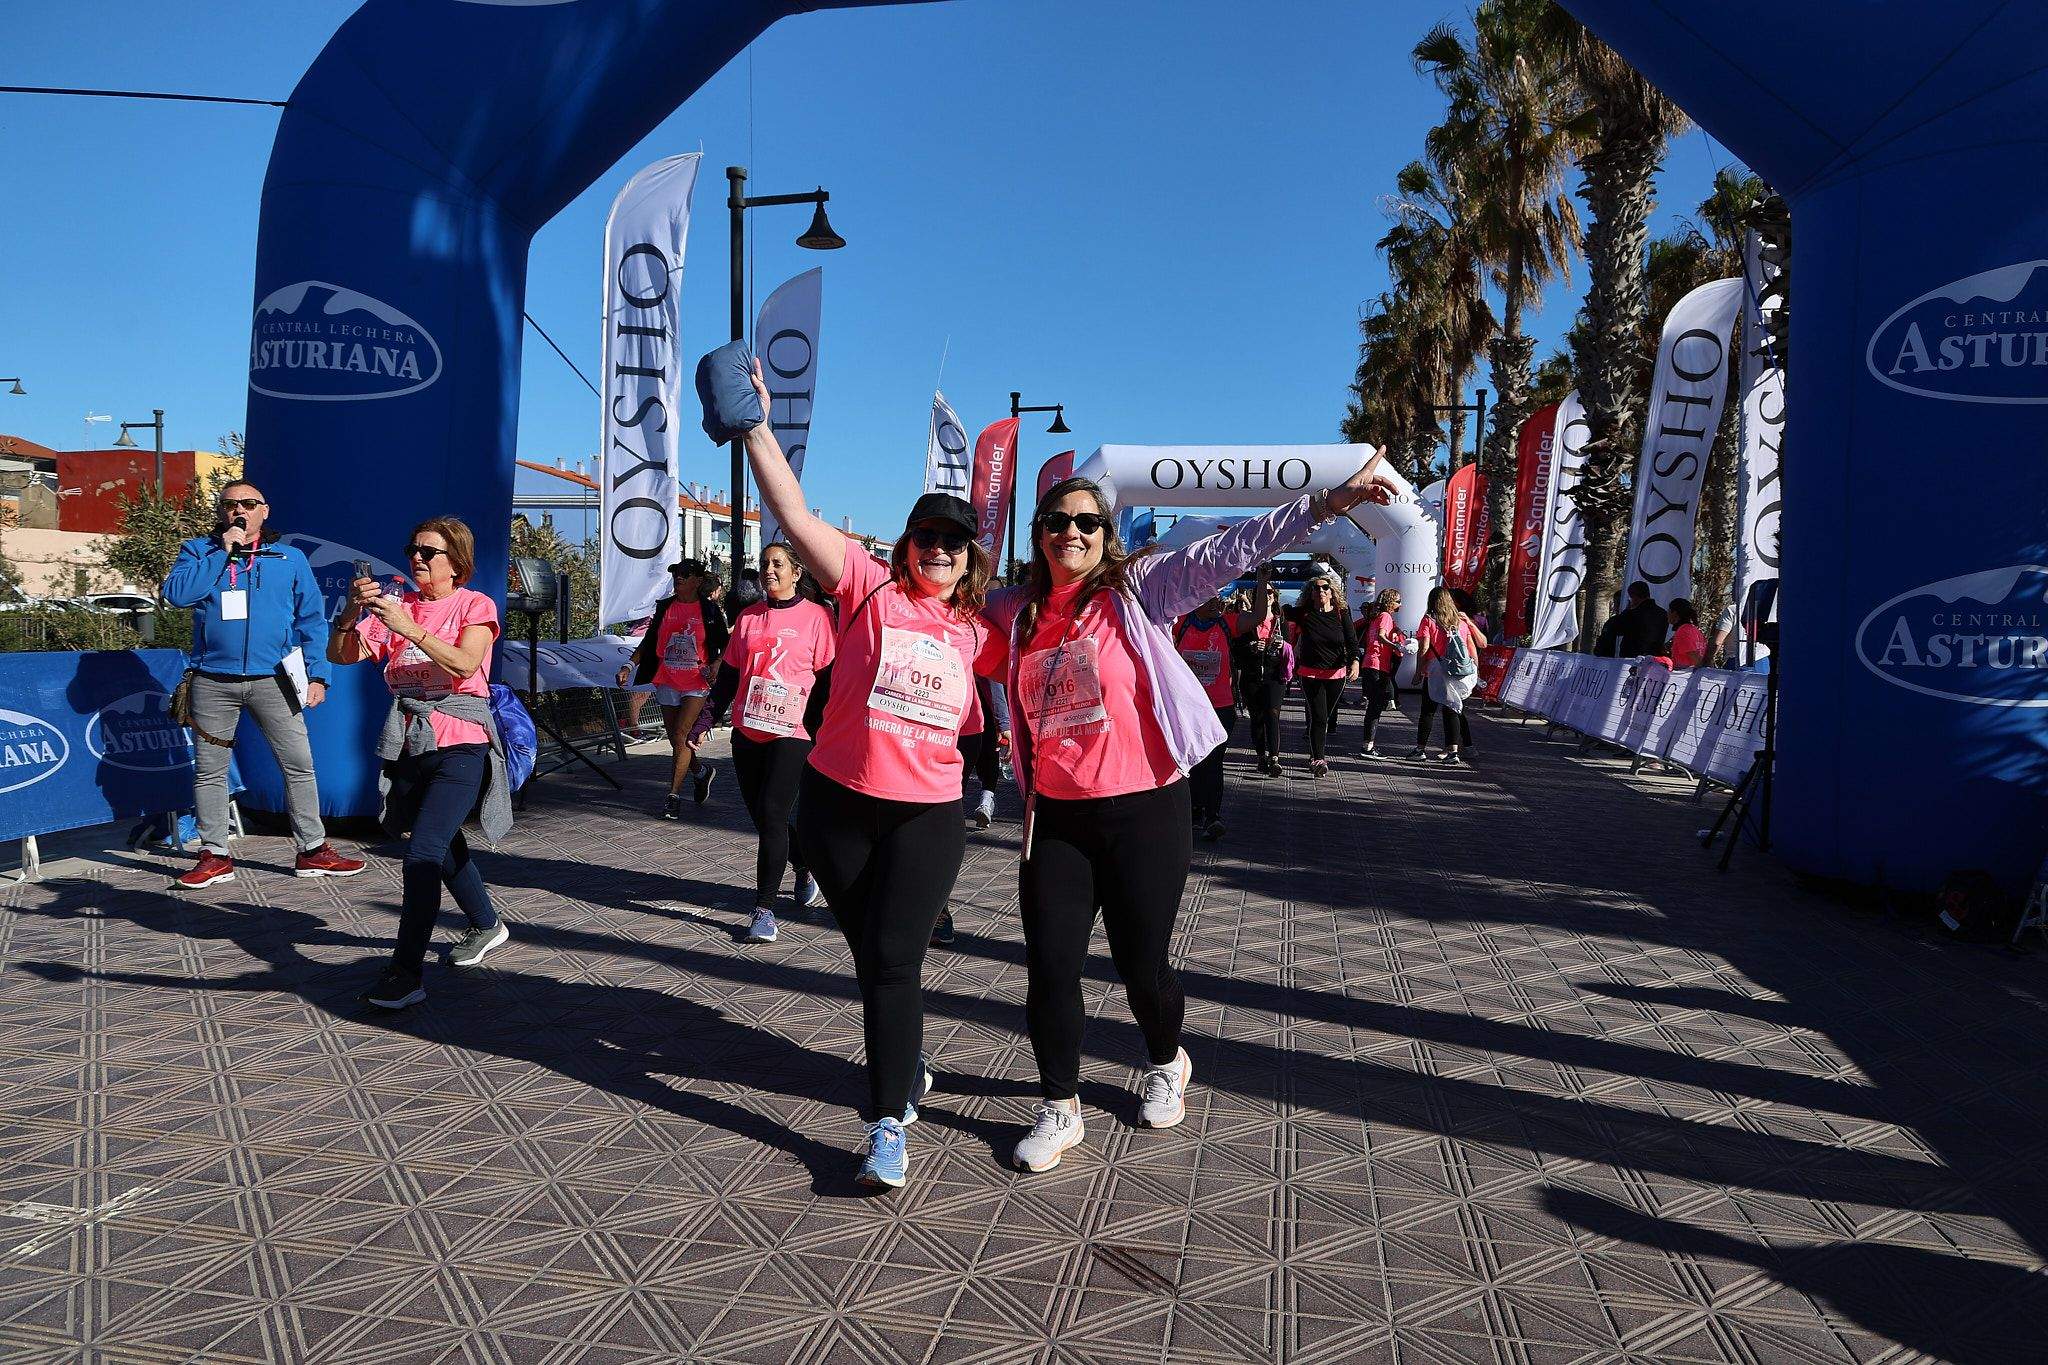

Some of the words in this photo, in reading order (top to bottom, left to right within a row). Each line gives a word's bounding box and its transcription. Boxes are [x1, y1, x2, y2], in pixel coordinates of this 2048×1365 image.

[262, 322, 321, 334] CENTRAL
[330, 323, 416, 344] LECHERA
[250, 329, 422, 381] ASTURIANA
[611, 242, 669, 560] OYSHO
[1638, 328, 1723, 585] OYSHO
[983, 444, 1005, 530] Santander
[1150, 458, 1312, 490] OYSHO
[1526, 431, 1554, 531] Santander
[1452, 487, 1467, 557] Santander
[1385, 563, 1432, 574] OYSHO
[1932, 613, 2040, 627] CENTRAL
[1877, 615, 2048, 669] ASTUR
[910, 670, 943, 691] 016
[914, 689, 930, 698] 4223
[1046, 679, 1075, 697] 016
[1570, 666, 1609, 700] OYSHO
[764, 703, 786, 714] 016
[879, 698, 910, 712] OYSHO
[103, 723, 194, 753] ASTURIA
[864, 715, 901, 734] CARRERA
[902, 723, 914, 738] DE
[915, 727, 925, 740] LA
[927, 729, 954, 746] MUJER
